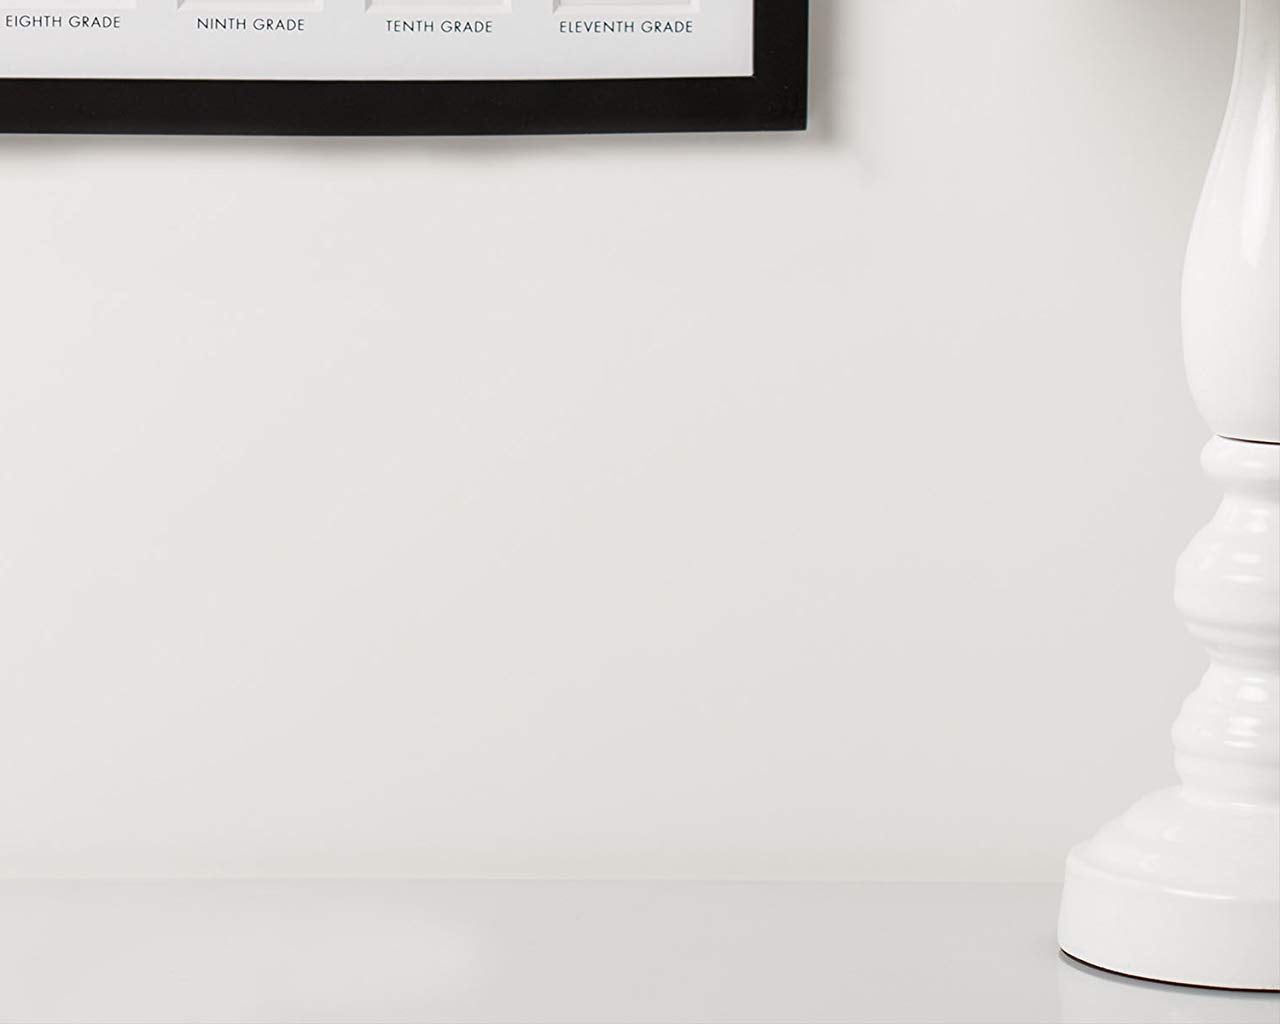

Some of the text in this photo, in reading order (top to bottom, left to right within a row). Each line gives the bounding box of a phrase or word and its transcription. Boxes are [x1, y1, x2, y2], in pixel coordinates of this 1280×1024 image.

[5, 14, 120, 29] EIGHTH GRADE
[197, 17, 305, 31] NINTH GRADE
[386, 20, 492, 33] TENTH GRADE
[559, 20, 693, 34] ELEVENTH GRADE
